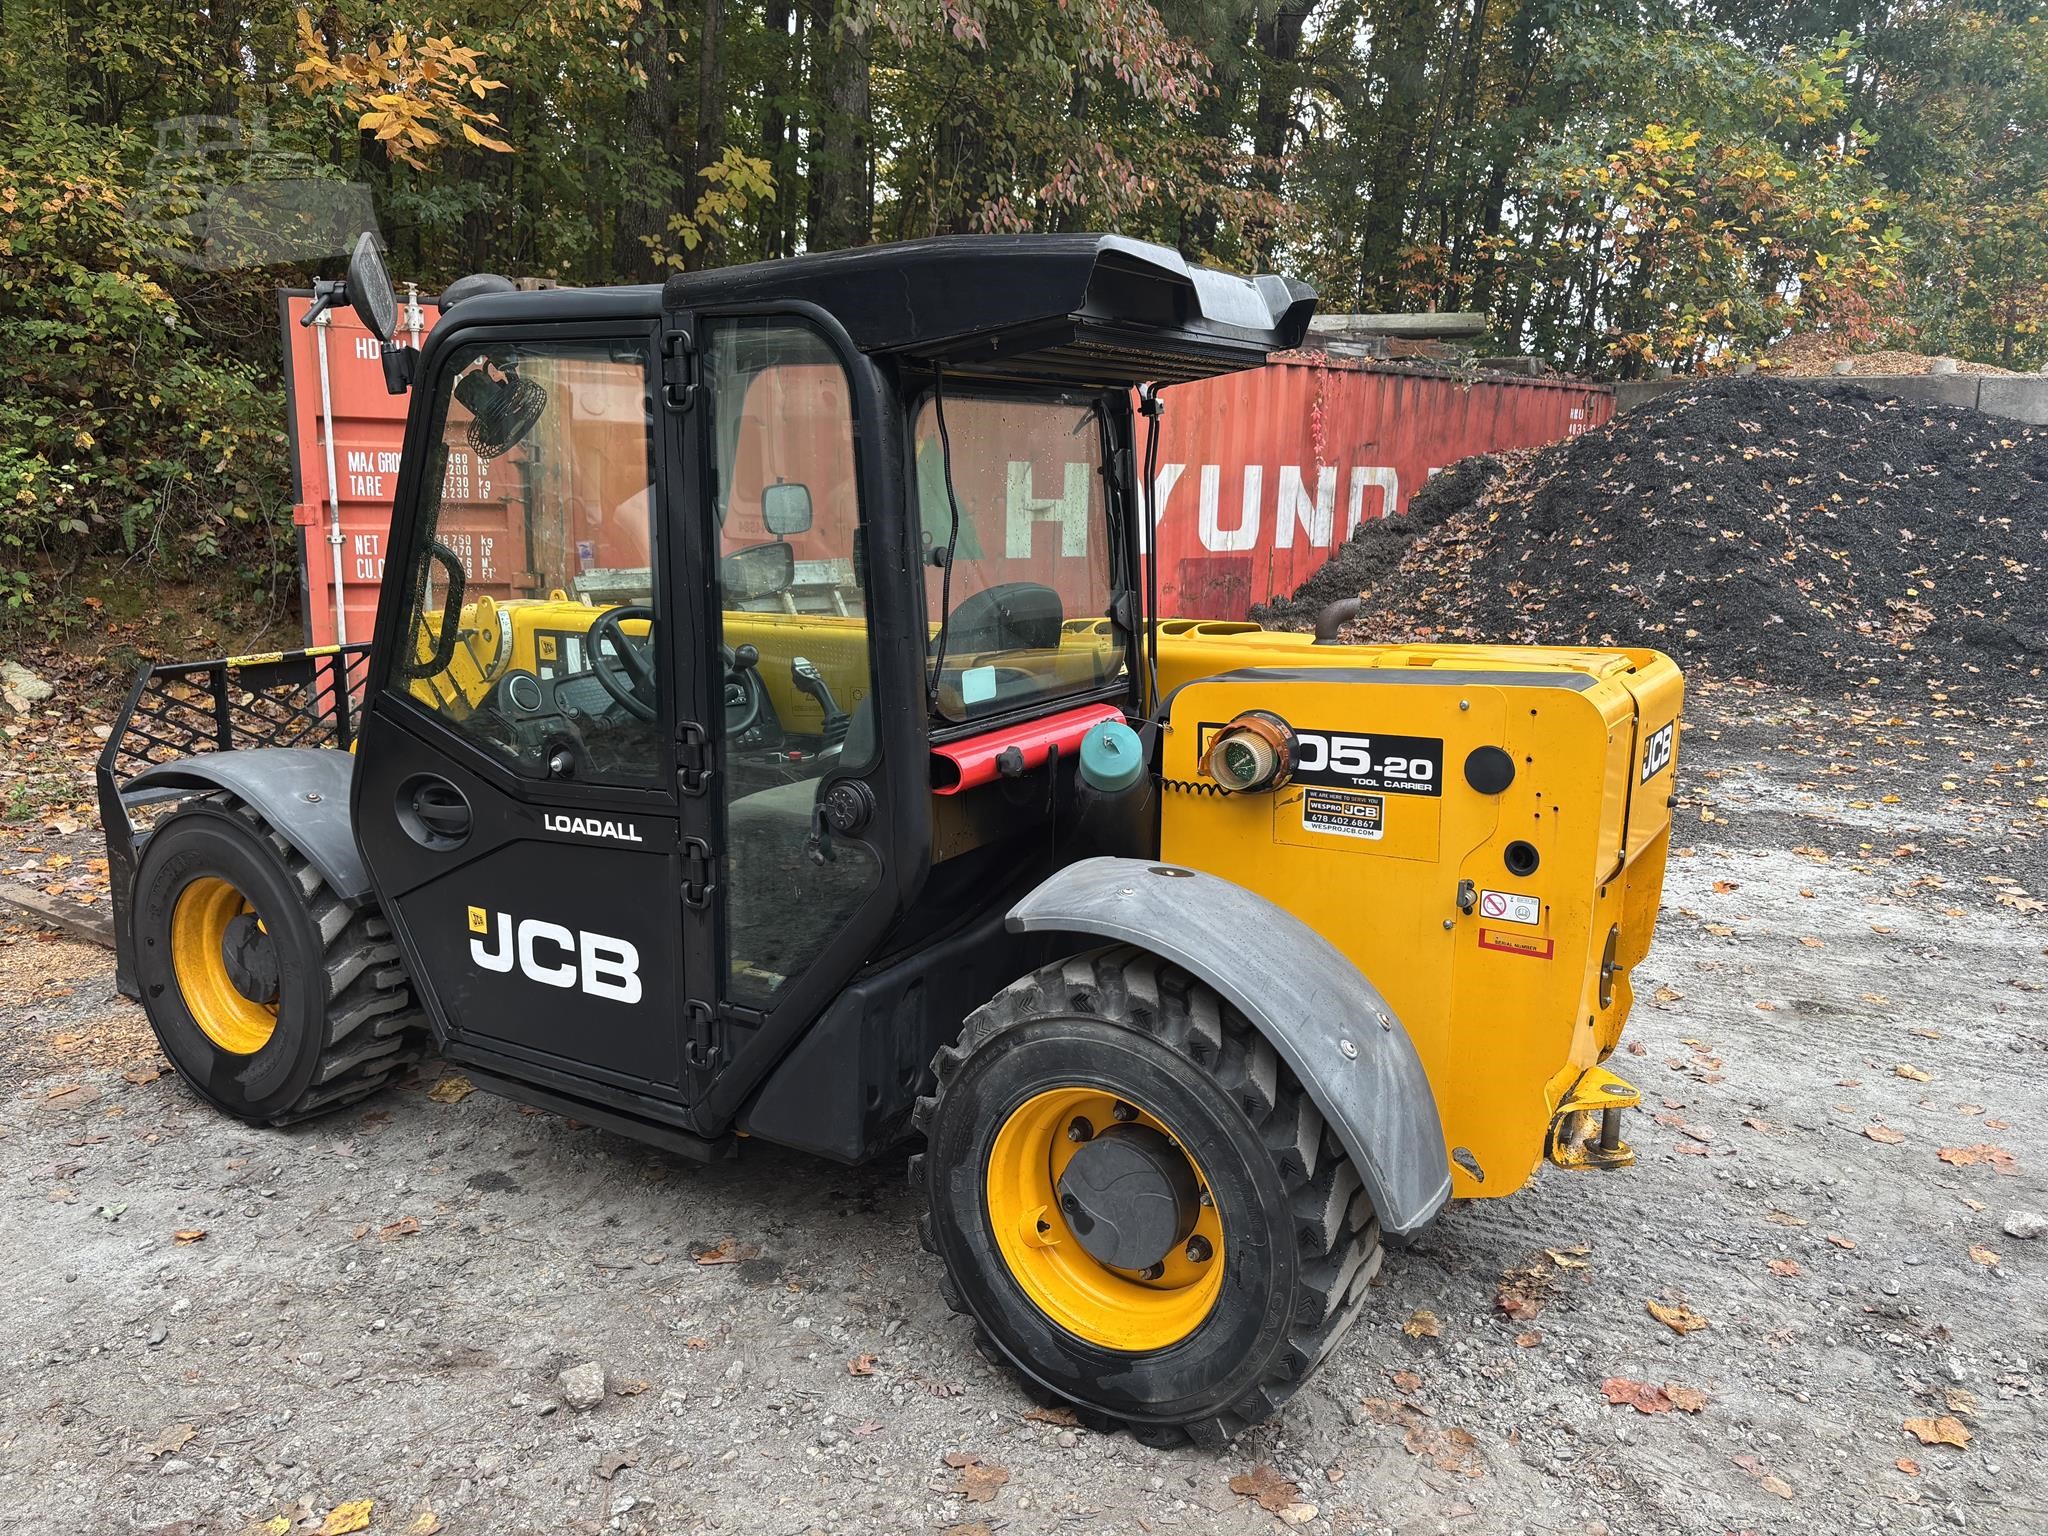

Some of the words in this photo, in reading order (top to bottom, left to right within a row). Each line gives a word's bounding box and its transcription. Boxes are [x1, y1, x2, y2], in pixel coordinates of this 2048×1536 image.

[348, 451, 374, 473] MAX
[447, 453, 468, 465] 480
[446, 464, 468, 476] .200
[478, 465, 487, 476] lb
[349, 475, 383, 496] TARE
[478, 476, 491, 491] kg
[479, 486, 489, 499] lb
[1005, 461, 1442, 560] HYUND
[354, 535, 379, 556] NET
[480, 534, 493, 549] kg
[481, 545, 491, 556] lb
[356, 558, 386, 579] CU.C
[1295, 734, 1434, 781] 05-20
[1642, 724, 1673, 780] JCB
[1351, 777, 1380, 787] TOOL
[1383, 780, 1433, 792] CARRIER
[1310, 802, 1342, 812] WESPRO
[1344, 804, 1377, 818] JCB
[544, 813, 643, 842] LOADALL
[1311, 813, 1374, 829] 678.402.6867
[1311, 823, 1374, 836] WESPROJCB.COM
[469, 911, 643, 1004] JCB
[1513, 943, 1537, 951] NUMBER
